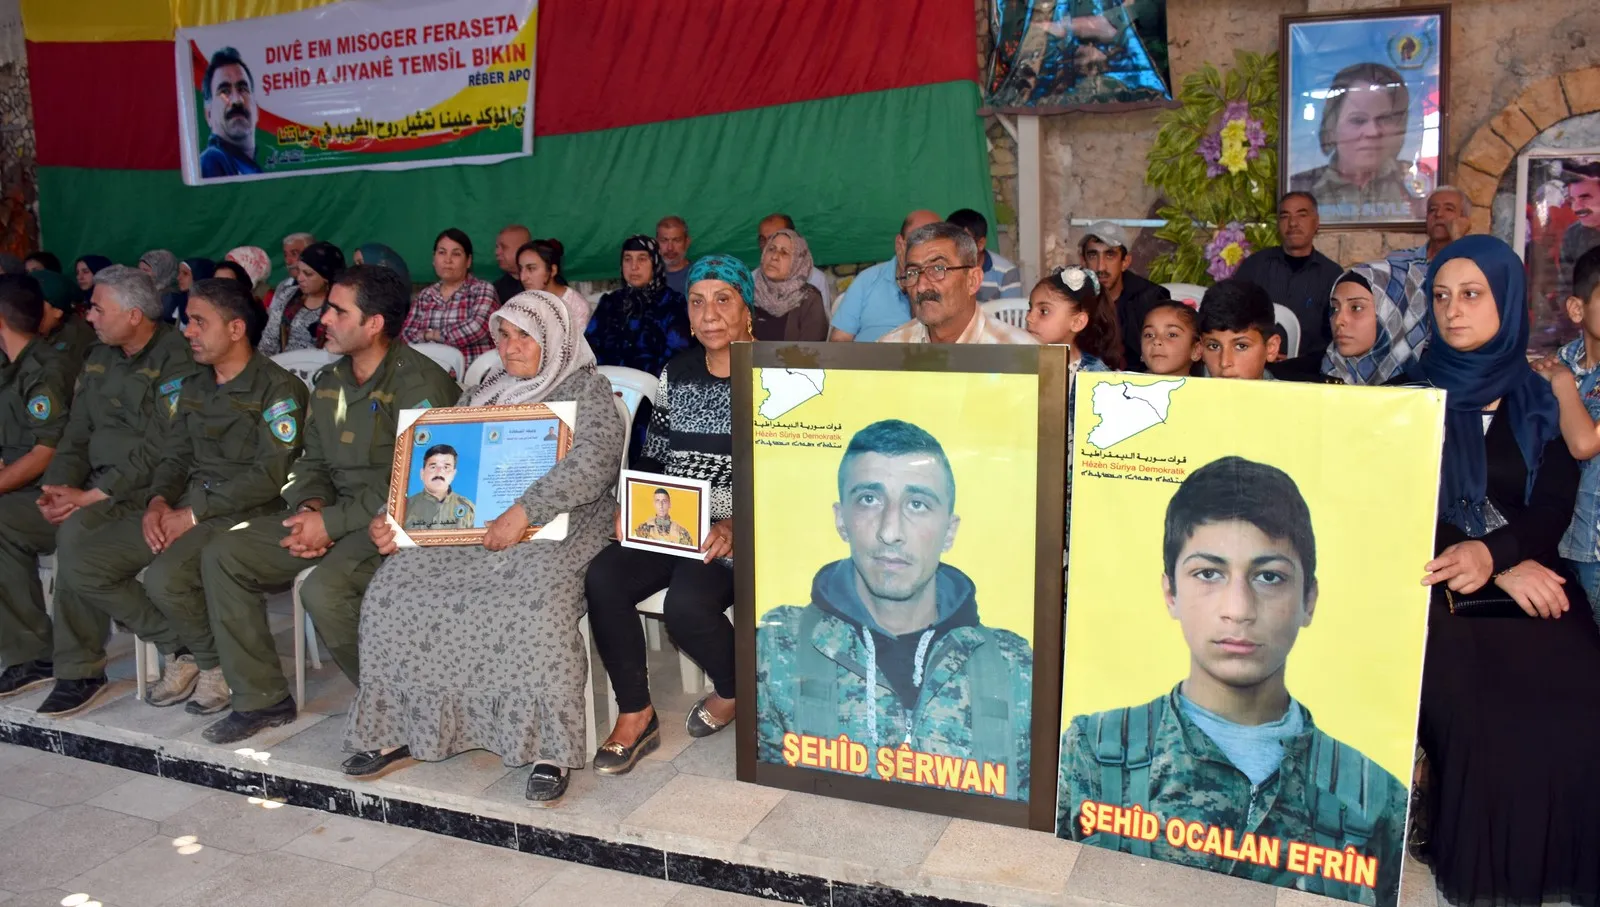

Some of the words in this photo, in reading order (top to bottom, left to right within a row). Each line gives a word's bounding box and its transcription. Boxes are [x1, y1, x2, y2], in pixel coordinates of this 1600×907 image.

[265, 41, 303, 65] DIVÊ
[307, 39, 333, 59] EM
[337, 28, 418, 55] MISOGER
[422, 14, 519, 44] FERASETA
[262, 67, 311, 95] ŞEHÎD
[316, 69, 328, 85] A
[332, 55, 394, 84] JIYANÊ
[399, 48, 467, 76] TEMSÎL
[472, 43, 527, 68] BIKIN
[468, 69, 505, 88] RÊBER
[508, 69, 531, 84] APO
[401, 110, 435, 137] تمثيل
[439, 111, 473, 133] علينا
[475, 106, 511, 129] المؤكد
[376, 121, 399, 139] روح
[1081, 449, 1135, 461] الديمقراطية
[1136, 453, 1166, 463] سورية
[1167, 456, 1187, 466] قوات
[783, 732, 870, 774] ŞEHÎD
[877, 747, 1007, 796] ŞÊRWAN
[1079, 800, 1160, 844] ŞEHÎD
[1165, 817, 1281, 868] OCALAN
[1287, 838, 1378, 889] EFRÎN
